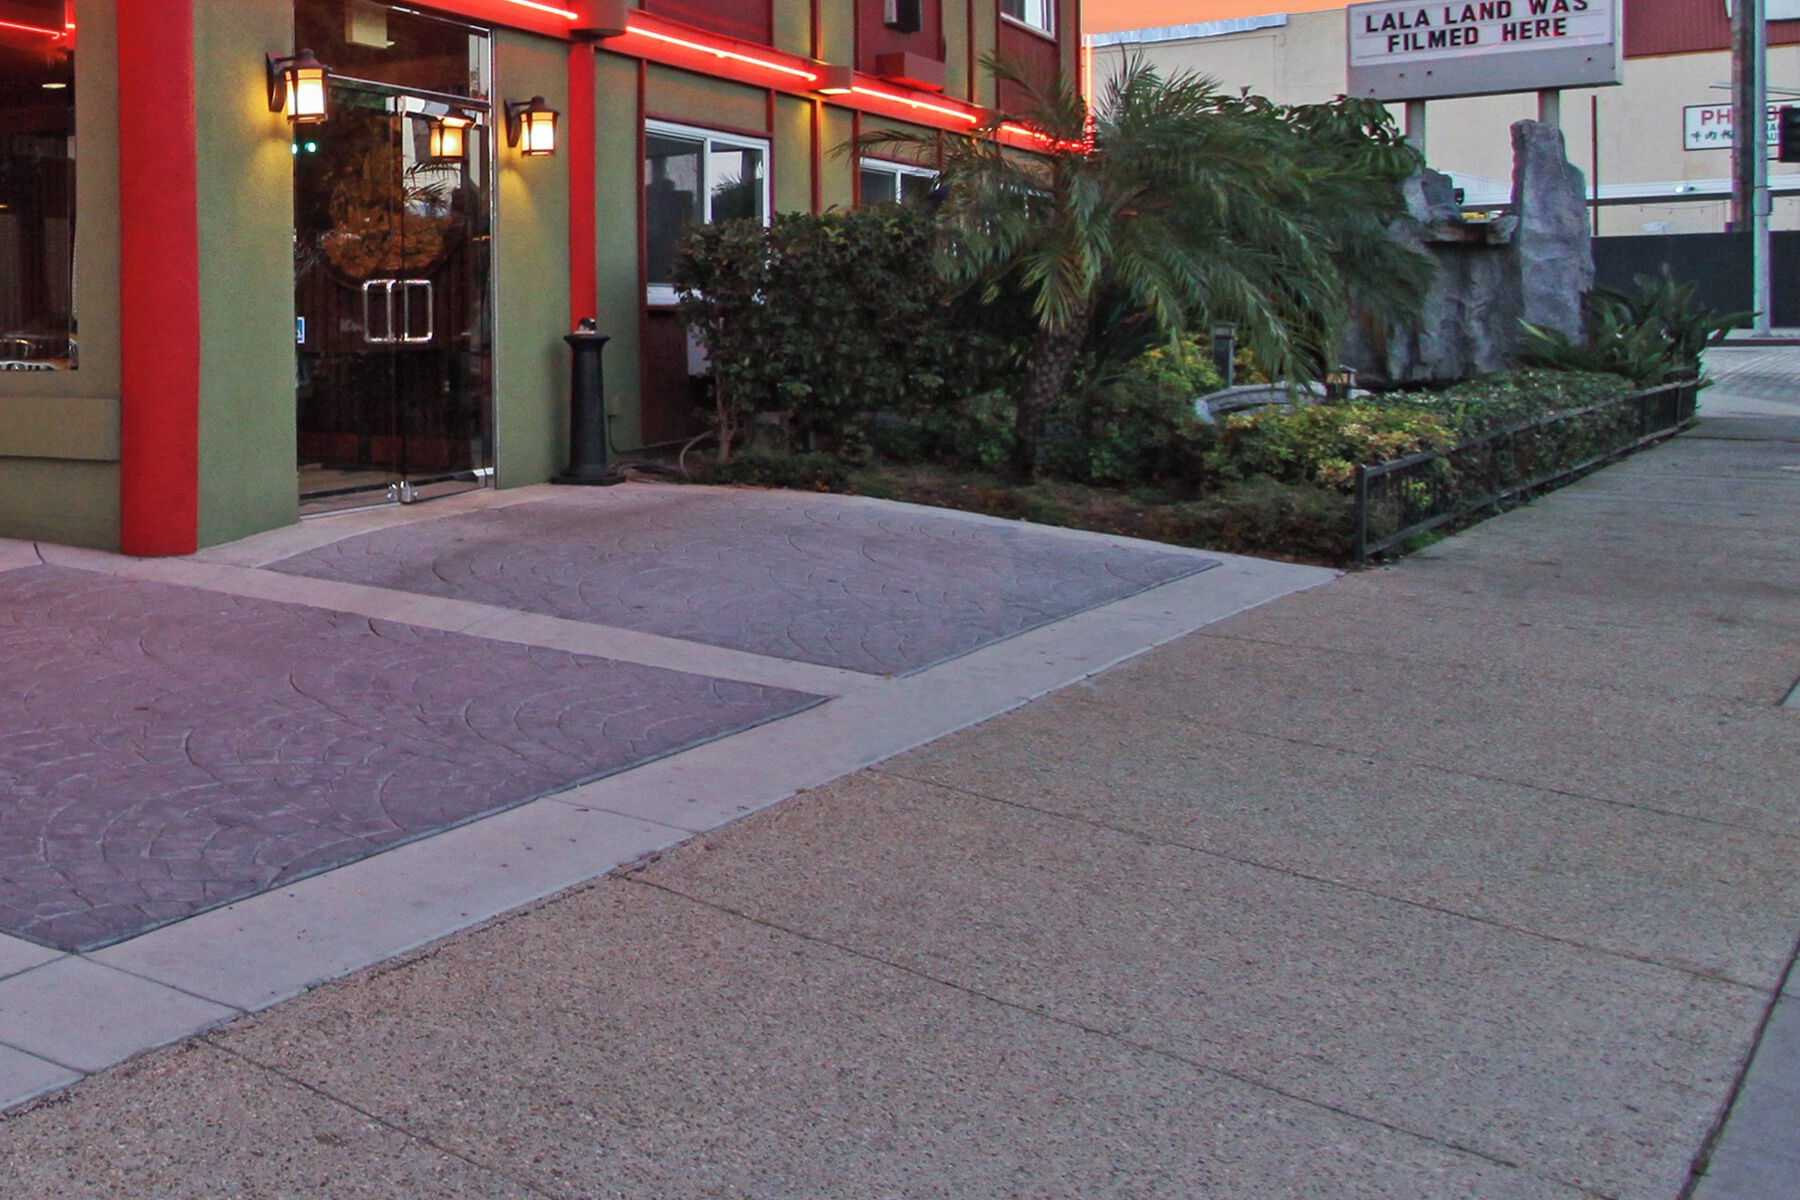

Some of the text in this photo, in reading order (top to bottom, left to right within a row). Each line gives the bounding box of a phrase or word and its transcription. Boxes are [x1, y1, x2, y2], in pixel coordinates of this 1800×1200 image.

[1364, 10, 1431, 34] LALA
[1444, 0, 1512, 25] LAND
[1387, 16, 1568, 54] FILMED HERE
